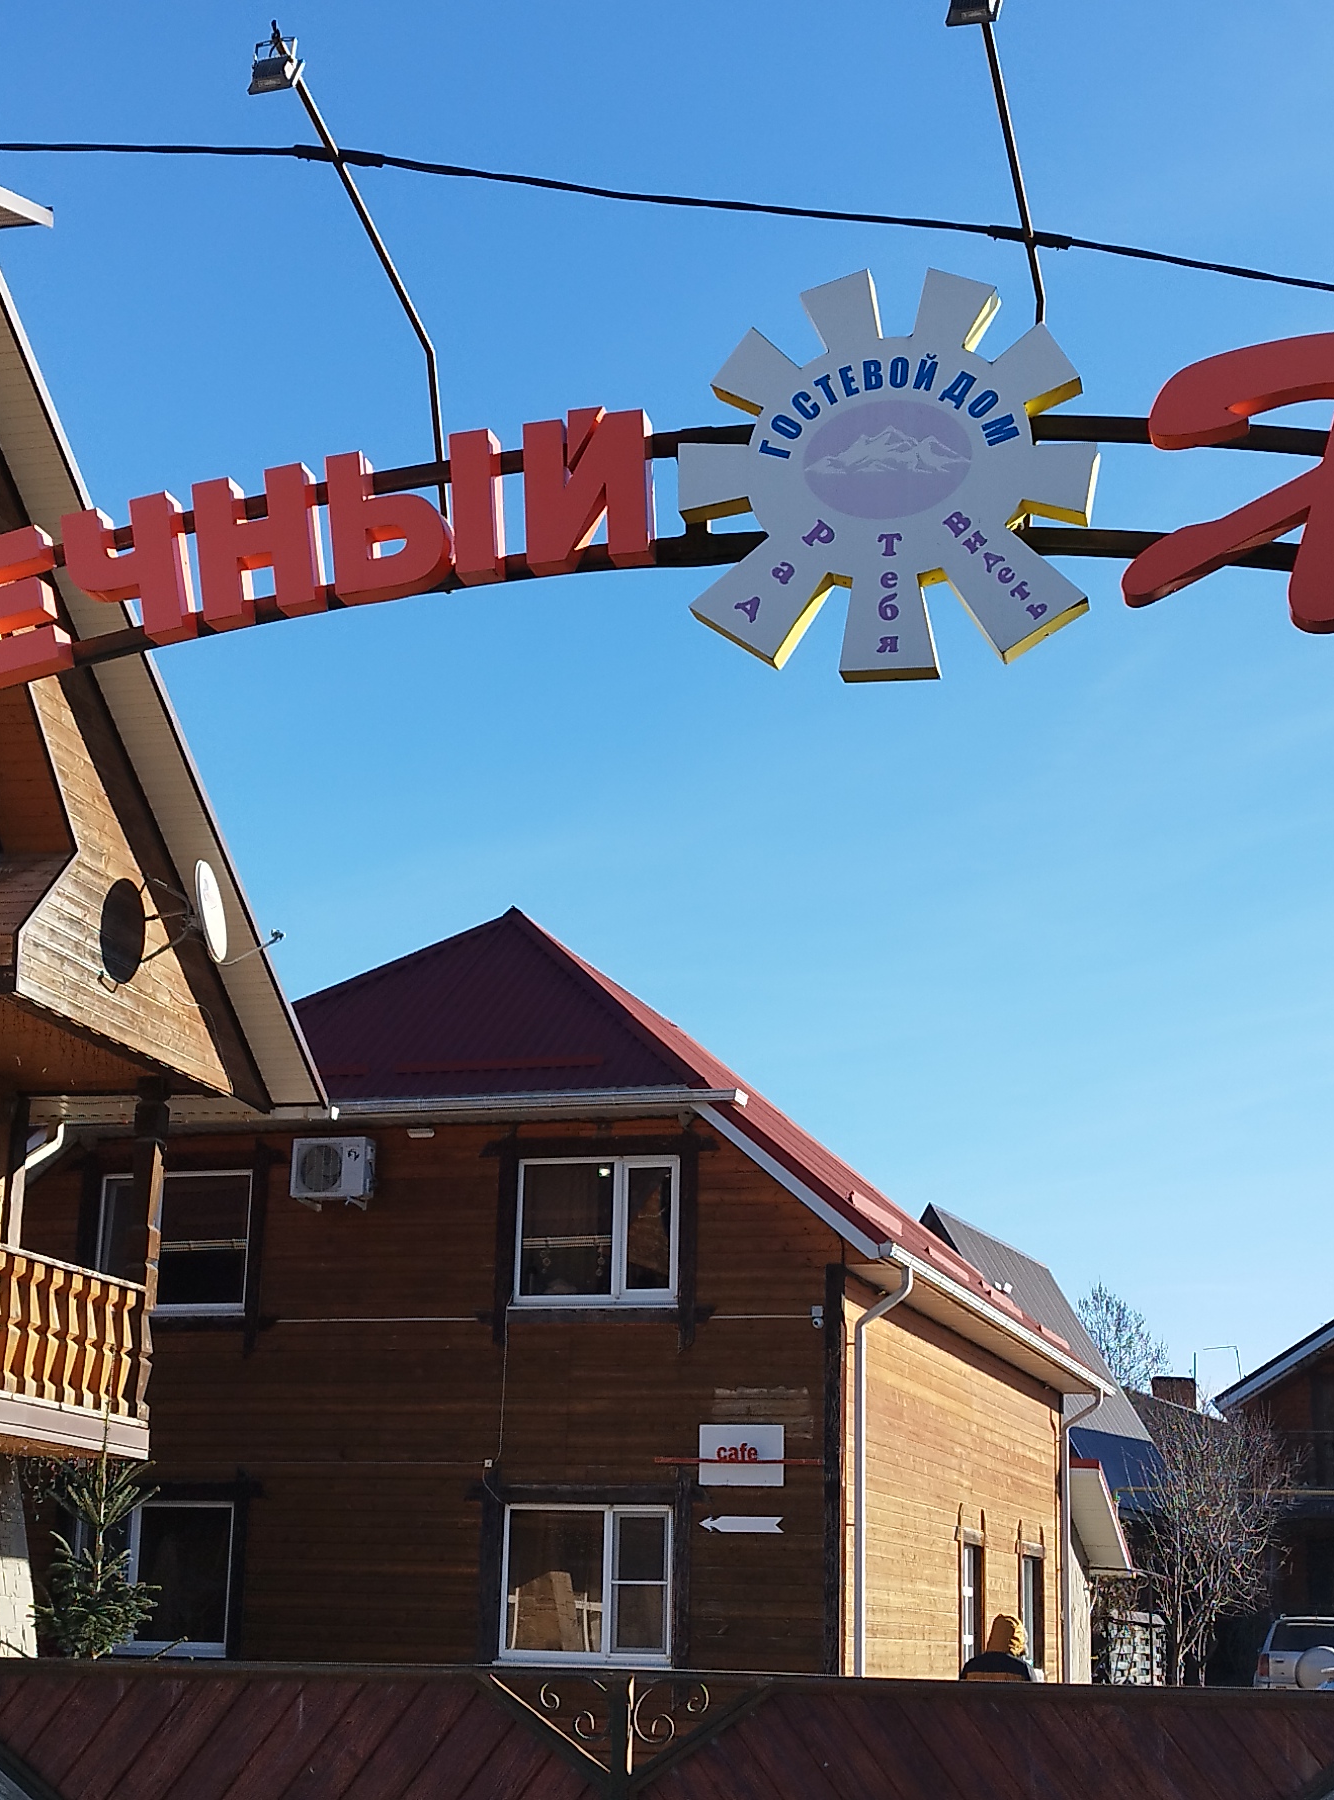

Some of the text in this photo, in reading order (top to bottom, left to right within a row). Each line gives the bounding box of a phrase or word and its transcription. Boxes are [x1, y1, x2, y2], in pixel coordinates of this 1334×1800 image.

[758, 353, 1020, 460] ГОСТЕВОЙ ДОМ
[875, 532, 903, 654] Тебя
[941, 510, 1048, 621] Видеть
[715, 1442, 759, 1461] cafe
